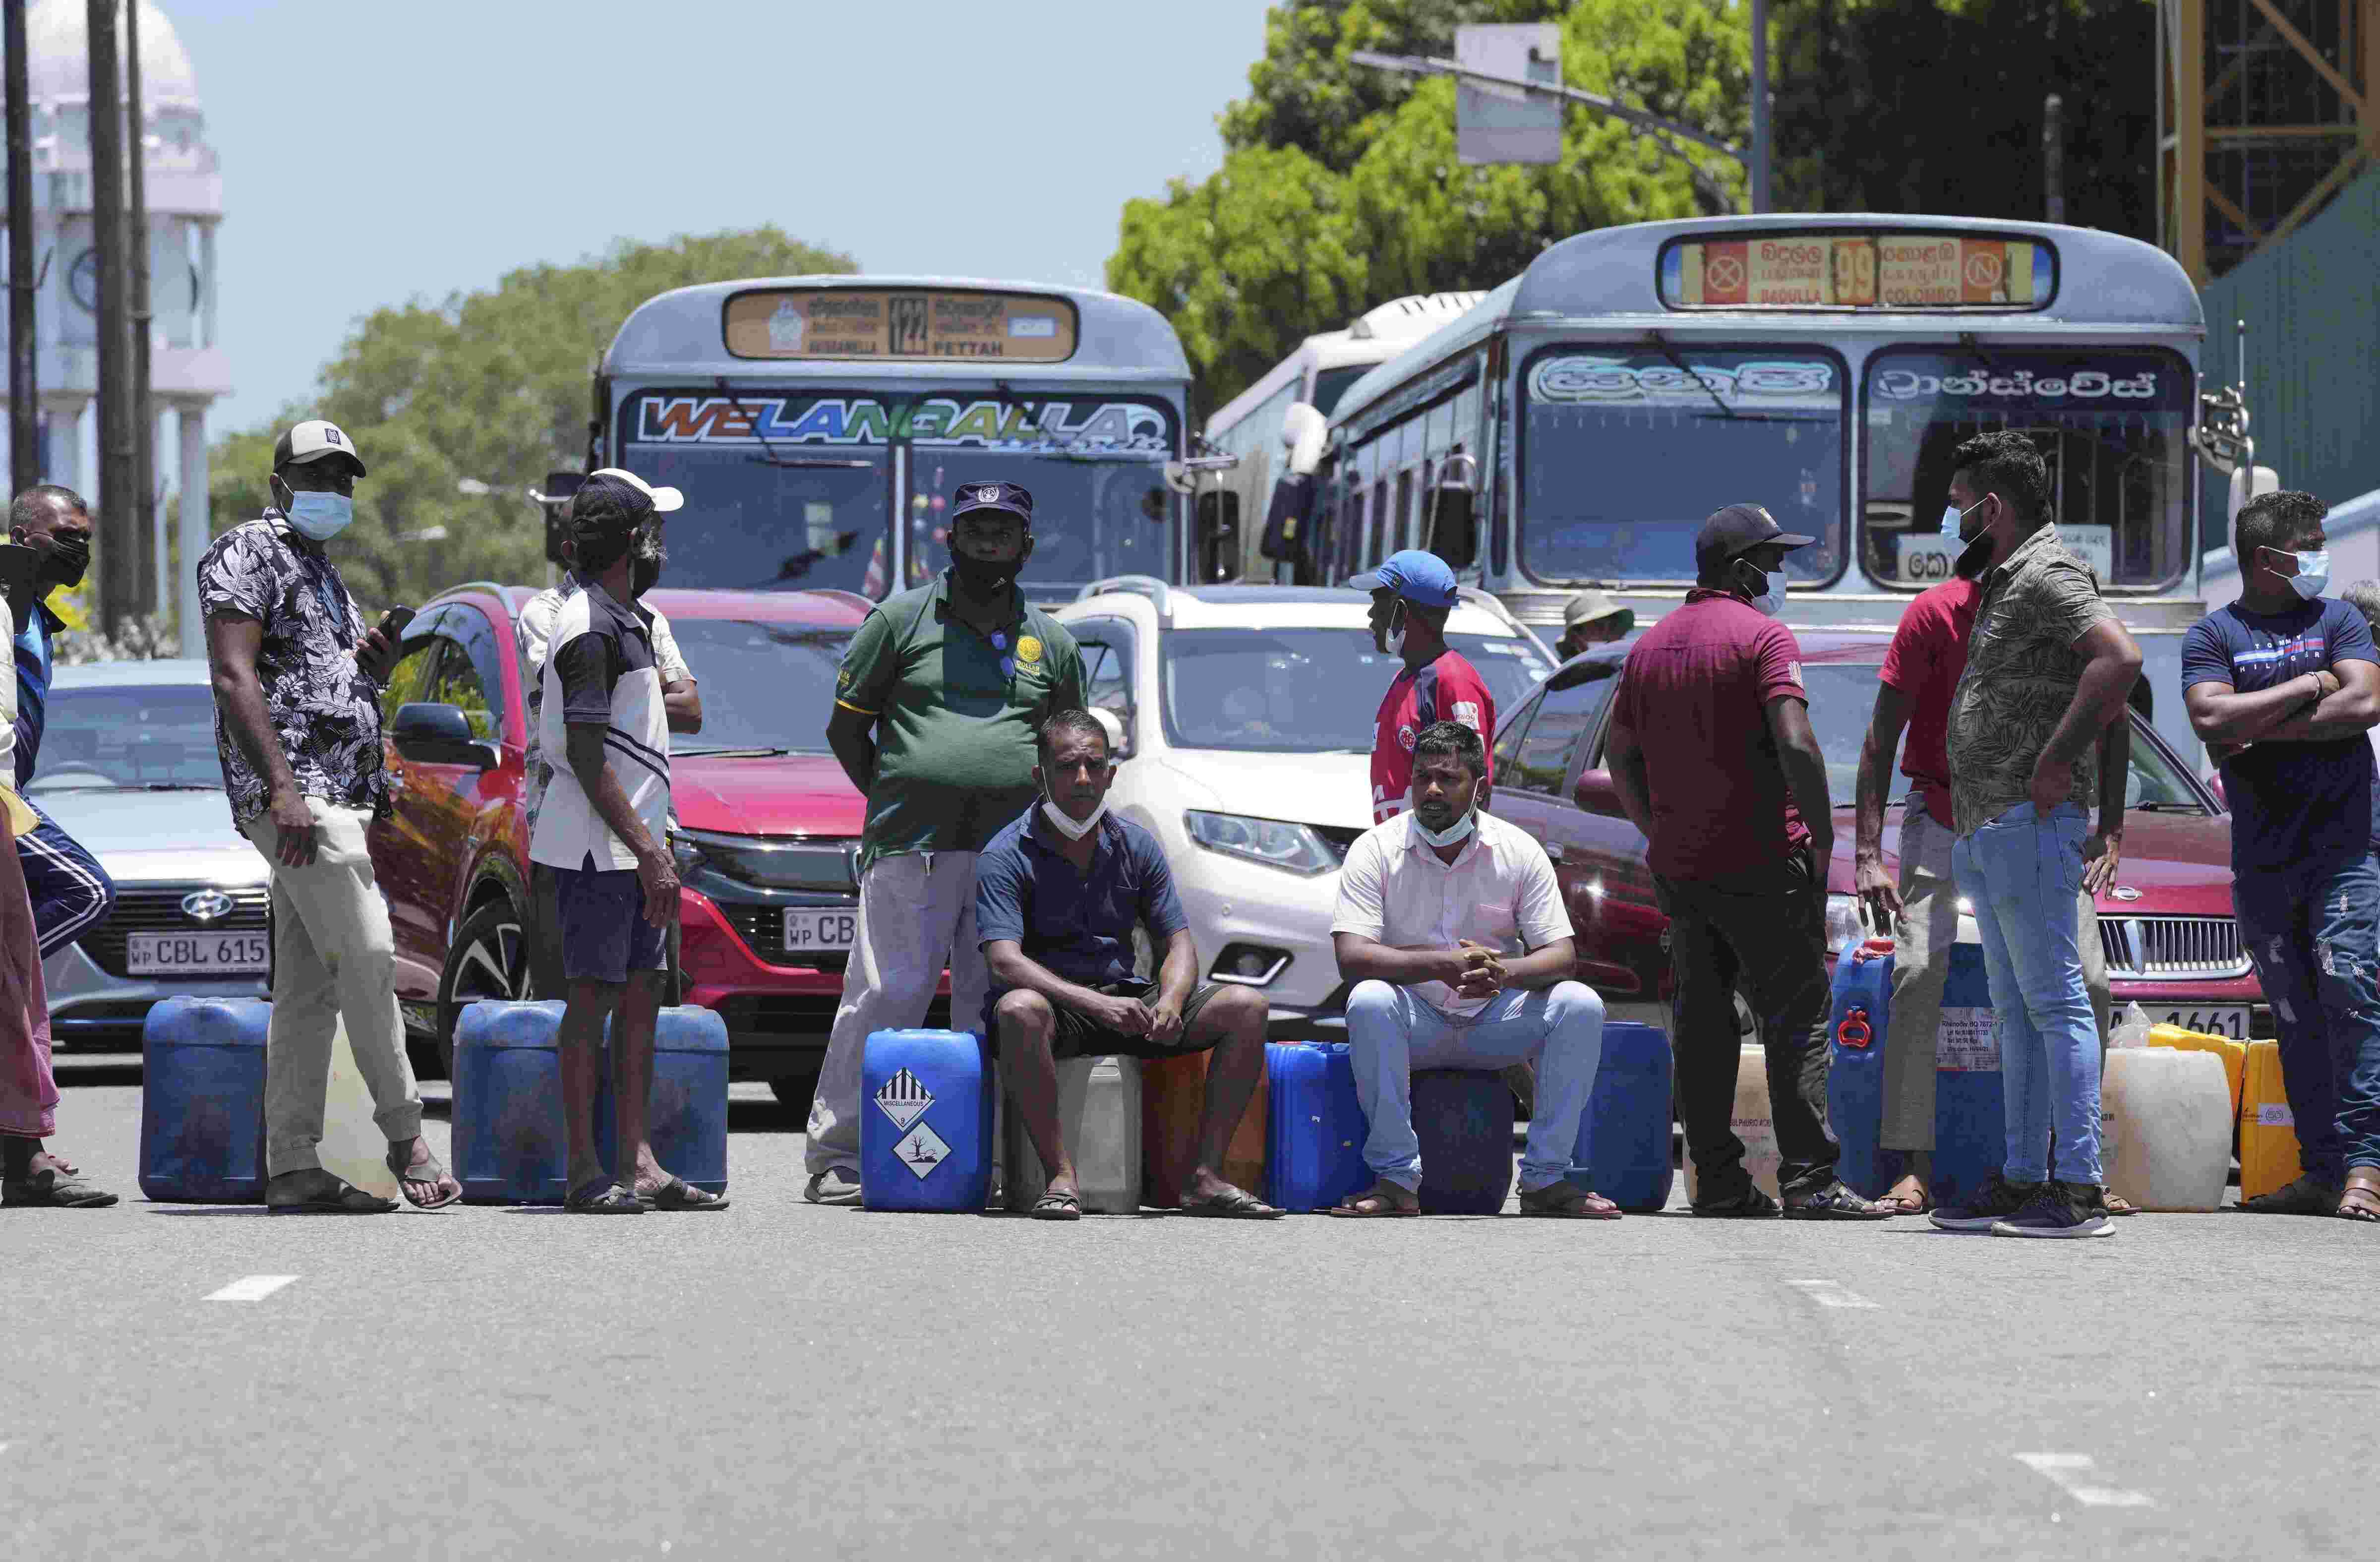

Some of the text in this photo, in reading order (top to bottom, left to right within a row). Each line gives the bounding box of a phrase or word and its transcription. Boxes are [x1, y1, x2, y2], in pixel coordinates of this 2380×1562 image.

[1885, 288, 1957, 302] COLOMBO
[934, 342, 1003, 357] PETTAH
[2255, 634, 2301, 649] TOMMY
[790, 916, 855, 944] WP CB
[157, 940, 208, 963] CBL
